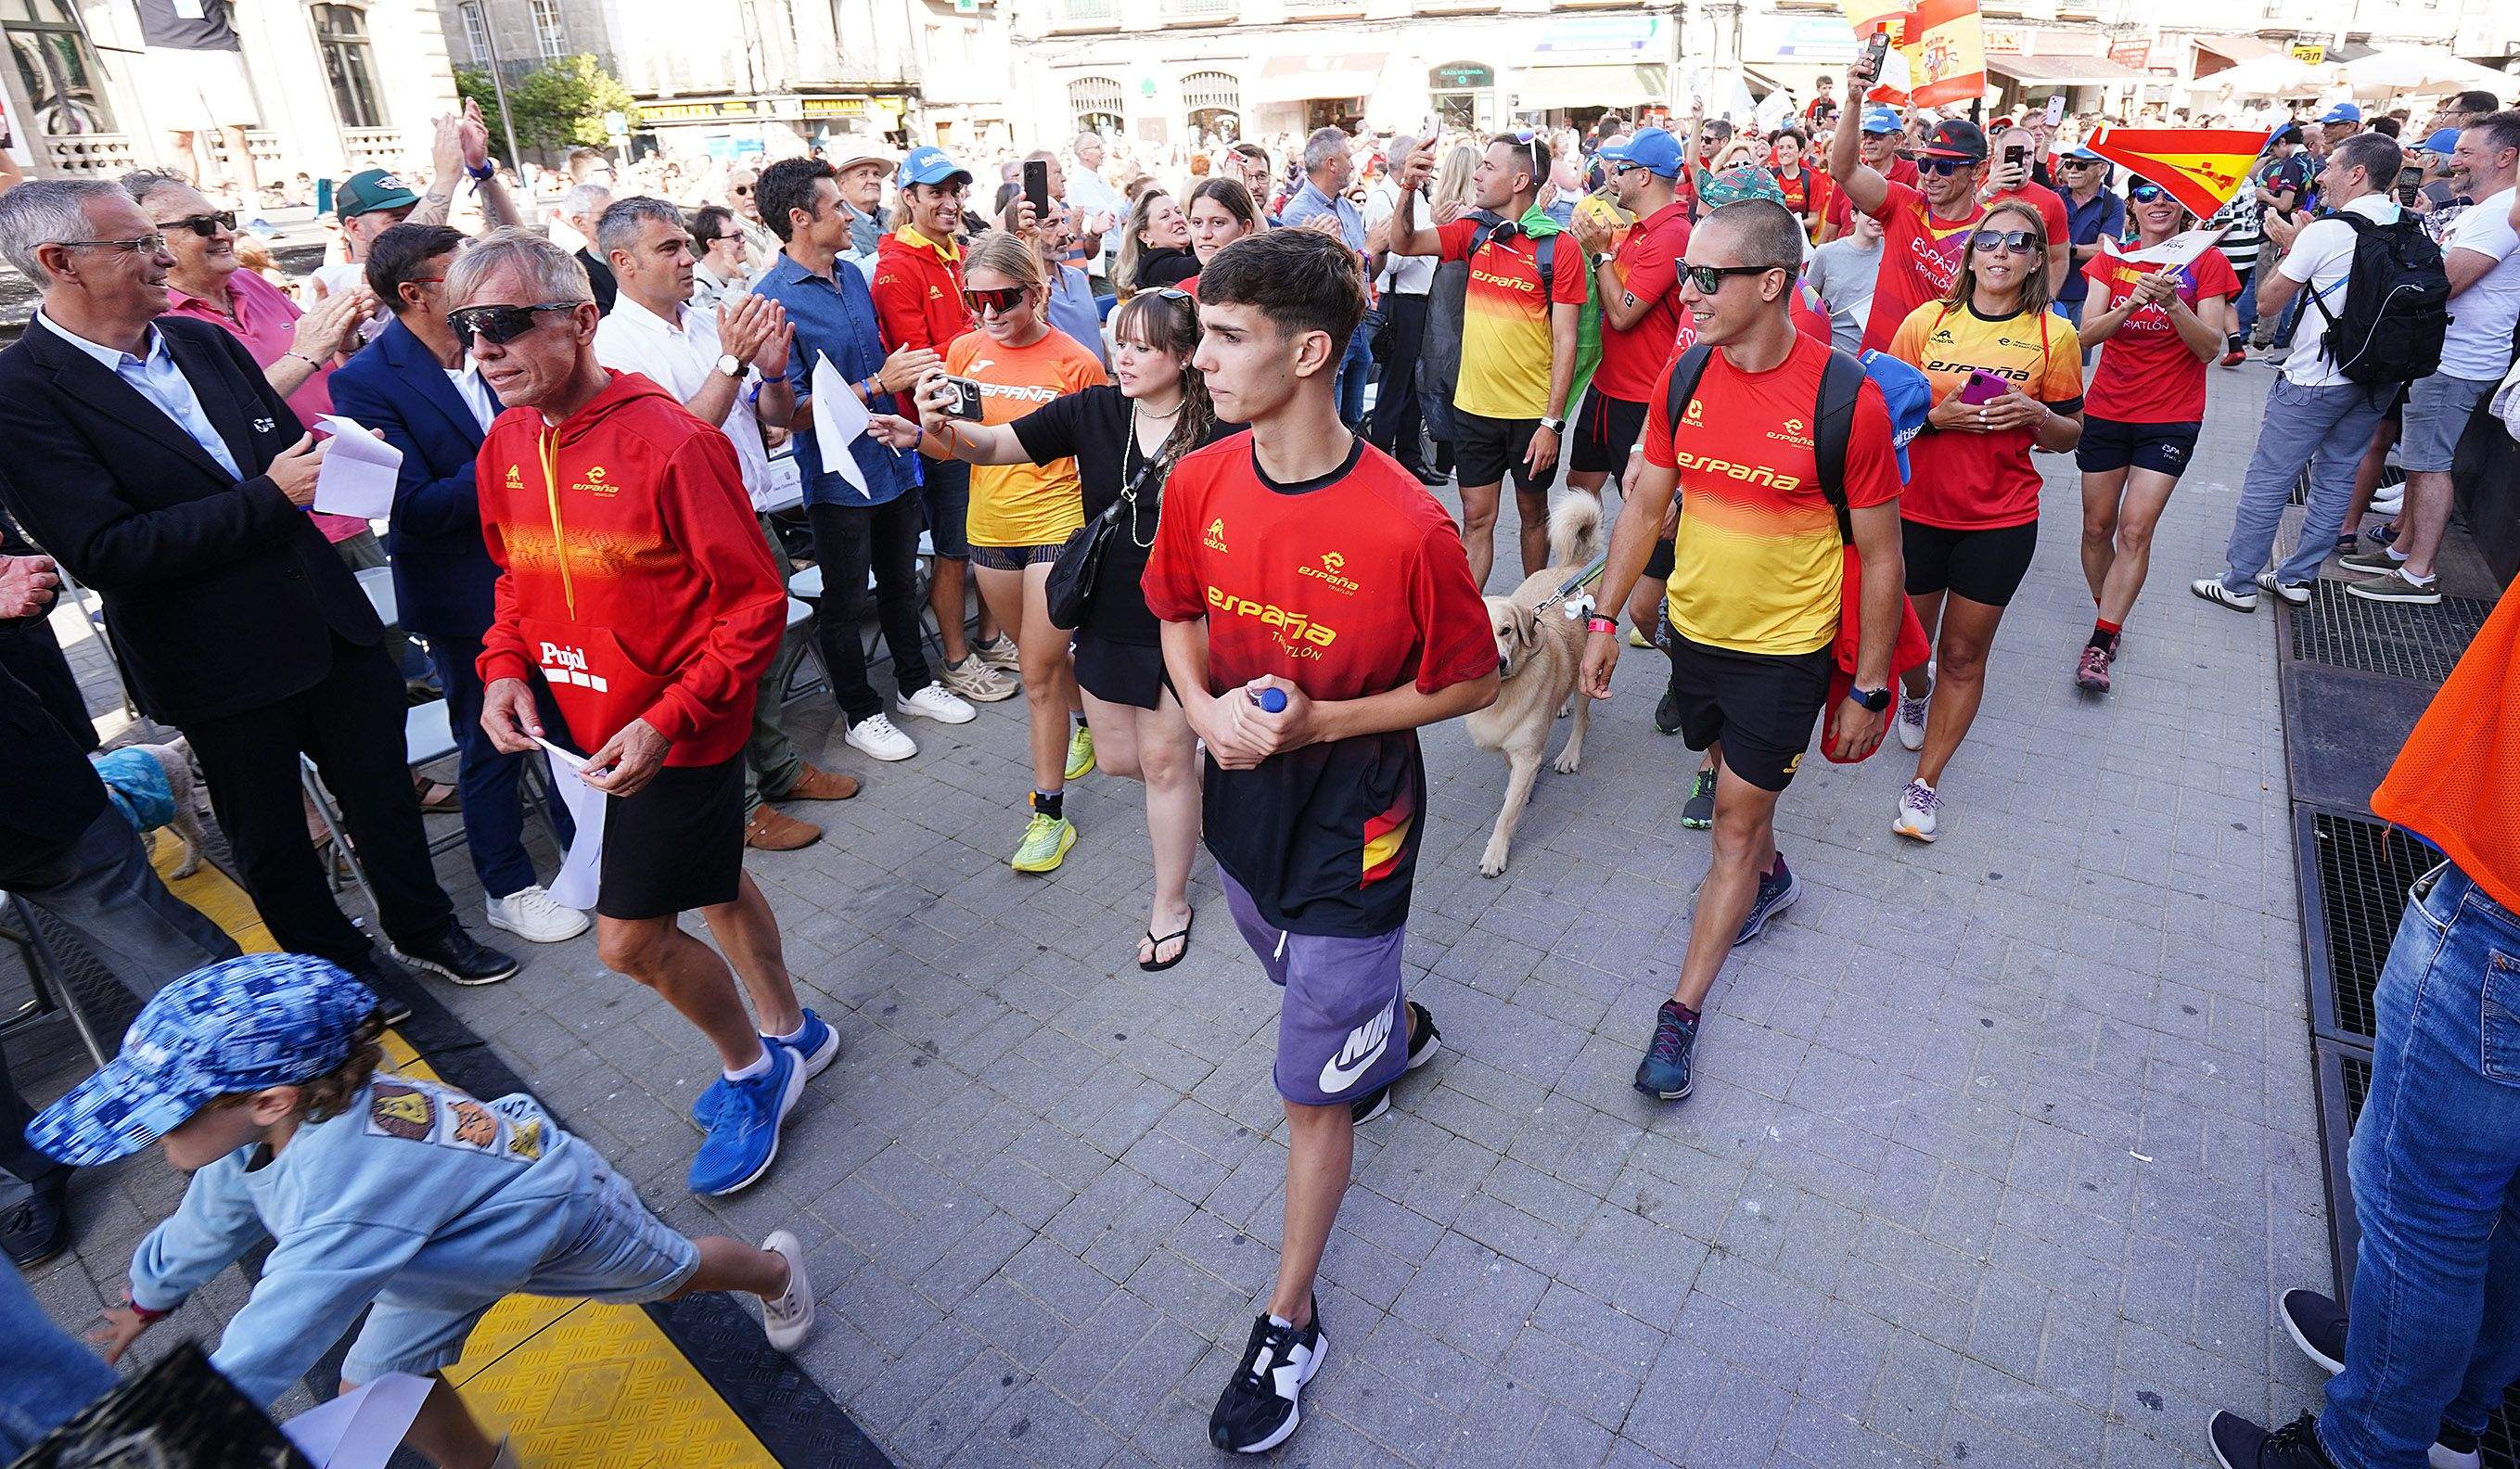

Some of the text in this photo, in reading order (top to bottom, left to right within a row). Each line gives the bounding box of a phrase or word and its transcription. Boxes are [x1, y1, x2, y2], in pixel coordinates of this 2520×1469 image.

[1472, 270, 1535, 292] españa
[2123, 319, 2169, 330] RIATLÓN
[979, 382, 1059, 402] SPAÑA
[1766, 431, 1815, 446] españa
[2162, 444, 2180, 454] ESPA
[1677, 452, 1800, 491] españa
[571, 483, 620, 493] españa
[1298, 566, 1360, 591] españa
[1208, 585, 1337, 646] españa
[540, 641, 589, 671] Pujol
[1338, 997, 1394, 1066] NIK
